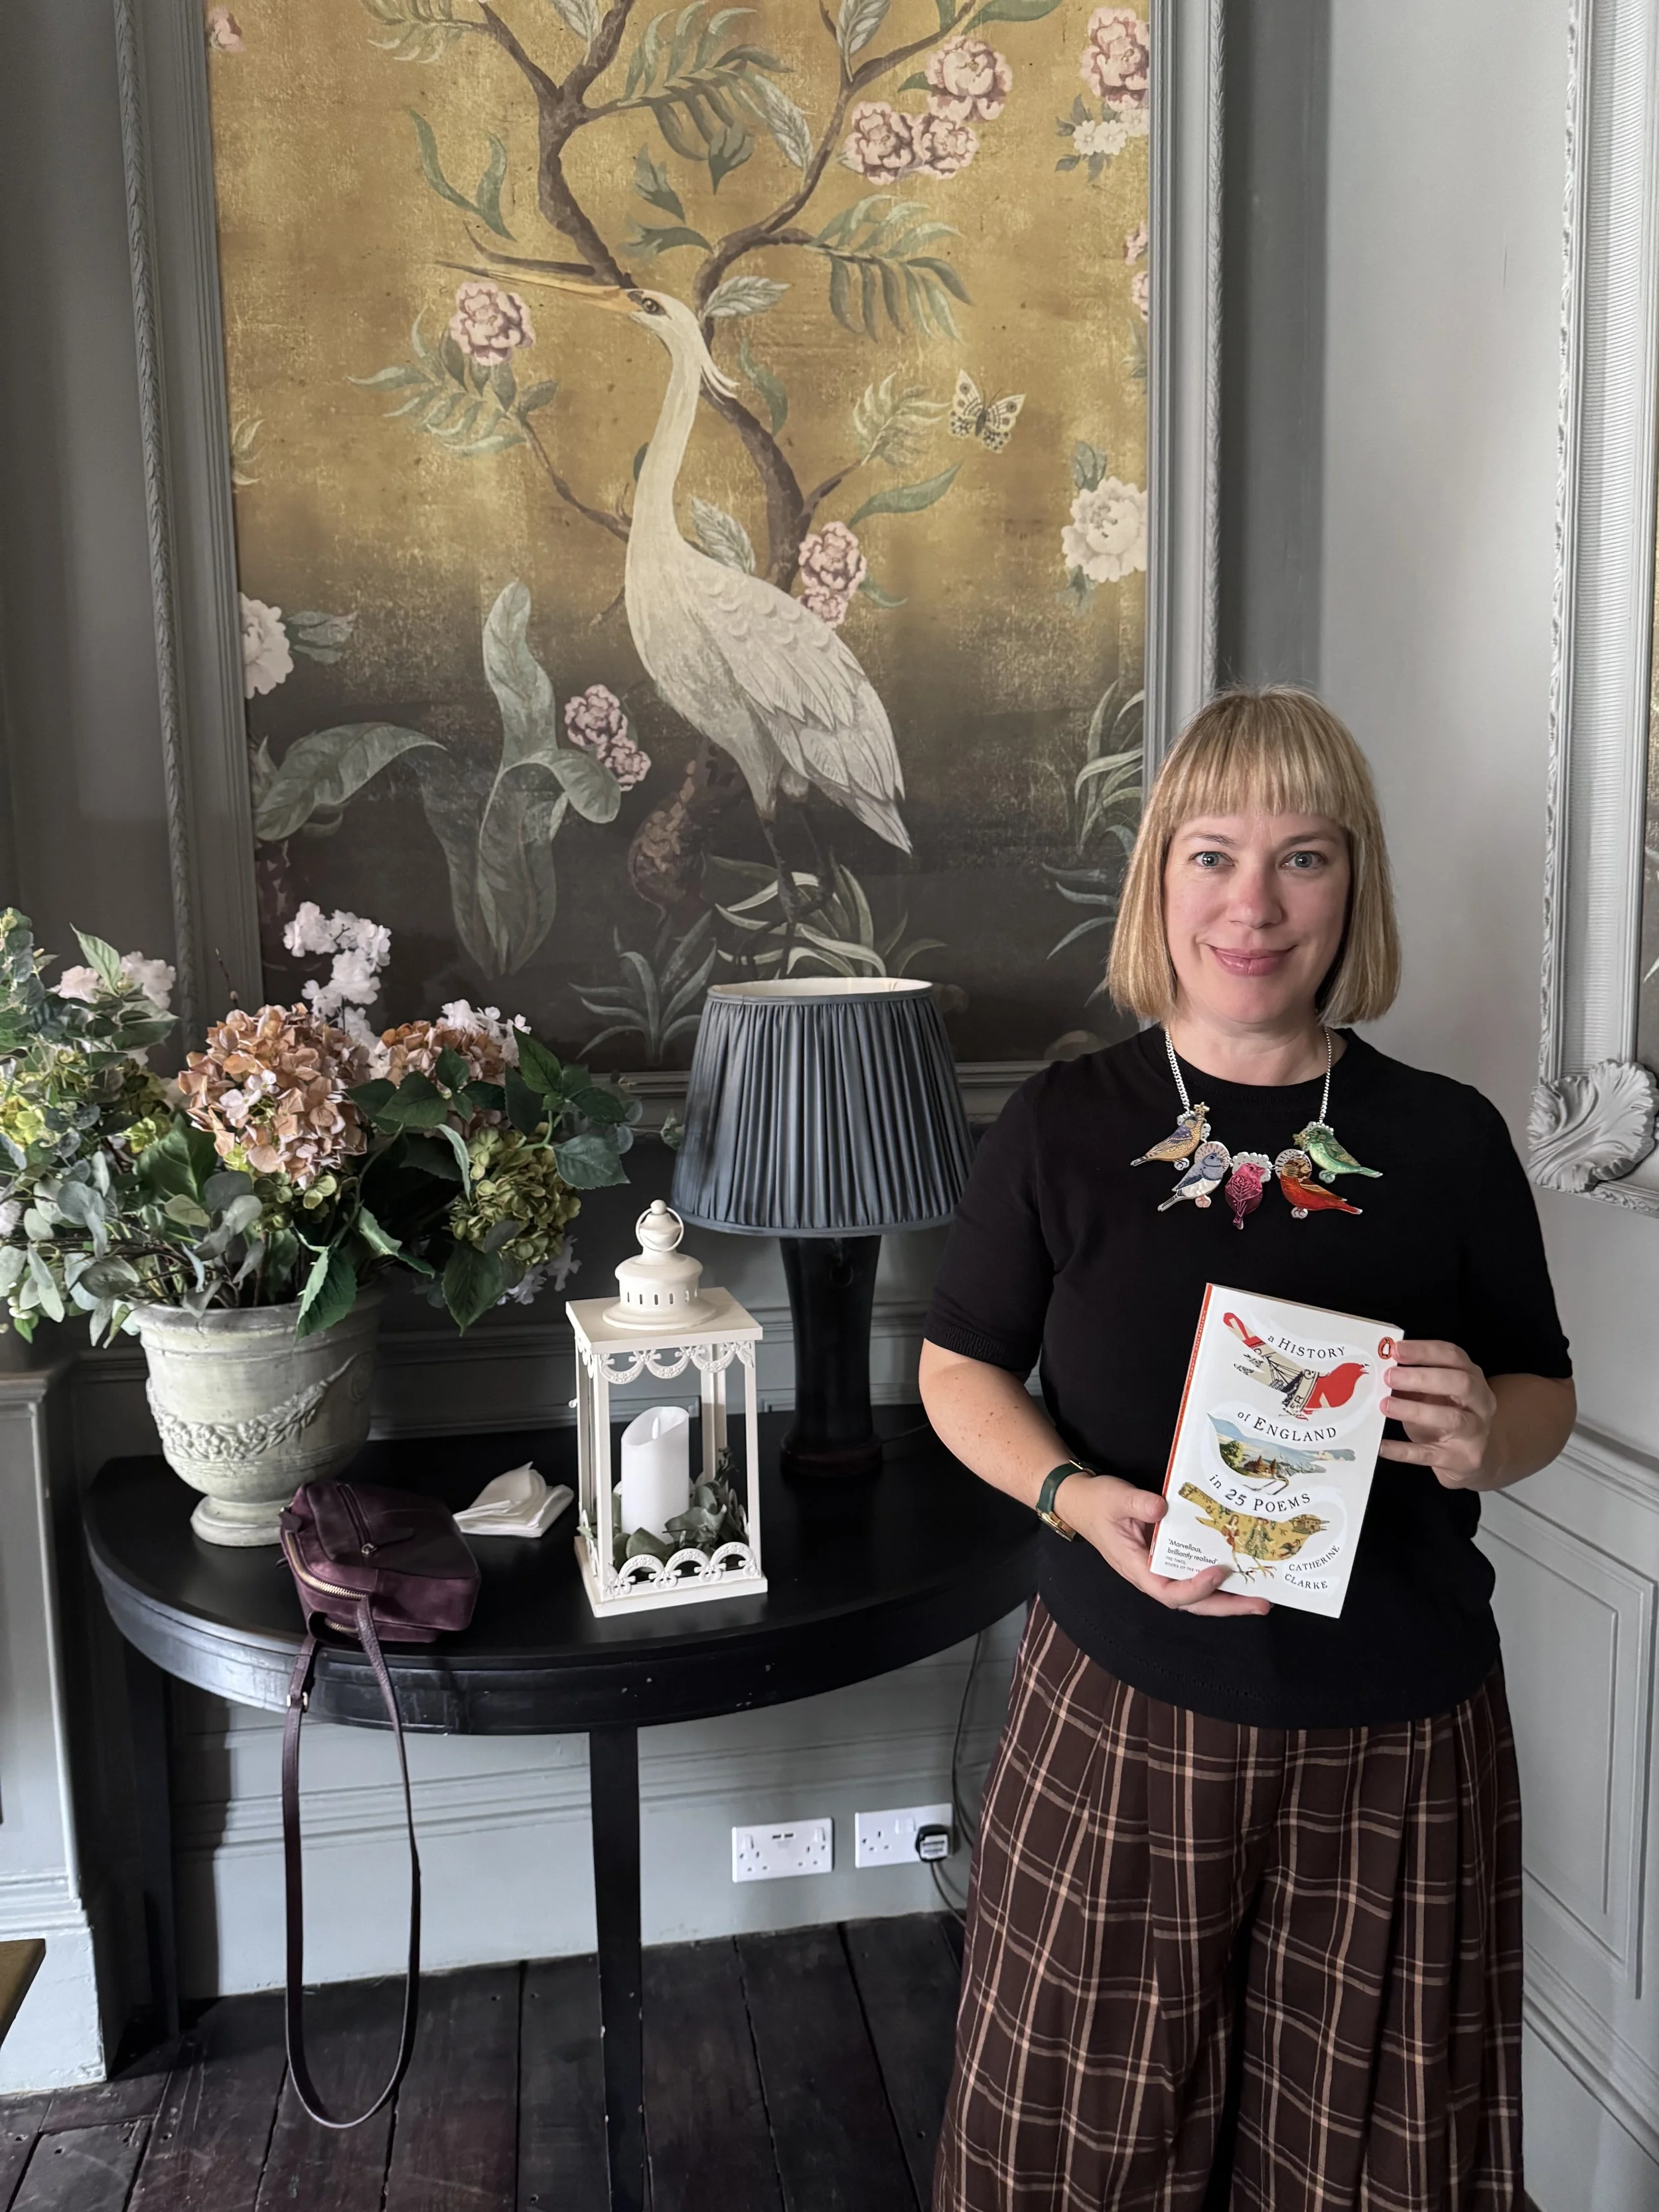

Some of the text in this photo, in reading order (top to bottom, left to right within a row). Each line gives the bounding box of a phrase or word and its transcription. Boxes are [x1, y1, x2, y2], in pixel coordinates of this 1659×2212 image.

[1278, 1337, 1345, 1359] HISTORY
[1238, 1412, 1336, 1442] of ENGLAND
[1209, 1474, 1311, 1512] in 25 POEMS
[1289, 1545, 1340, 1572] CATHERINE
[1285, 1574, 1328, 1589] CLARKE
